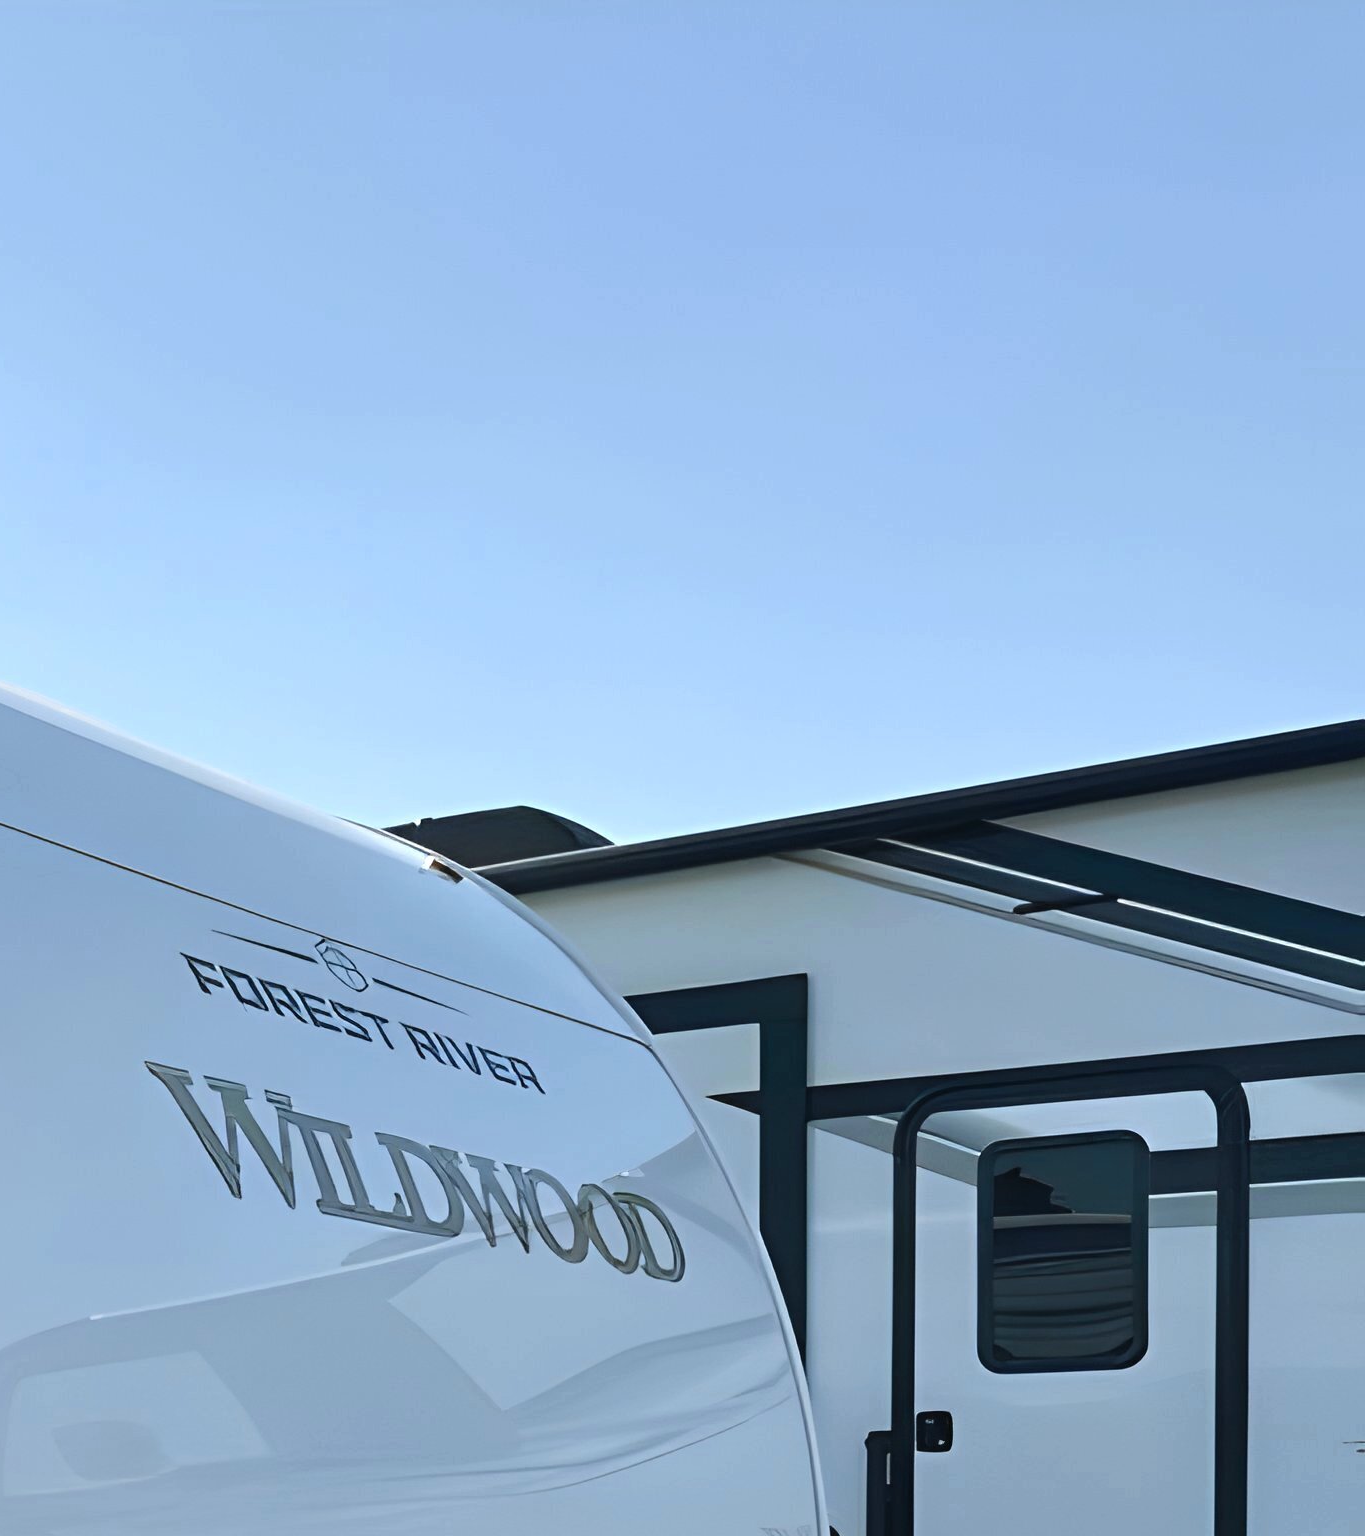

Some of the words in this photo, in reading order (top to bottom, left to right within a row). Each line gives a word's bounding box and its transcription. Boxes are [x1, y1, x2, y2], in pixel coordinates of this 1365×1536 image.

[180, 952, 397, 1050] FOREST
[398, 1022, 546, 1095] RIVER
[144, 1060, 686, 1282] WILDWOOD
